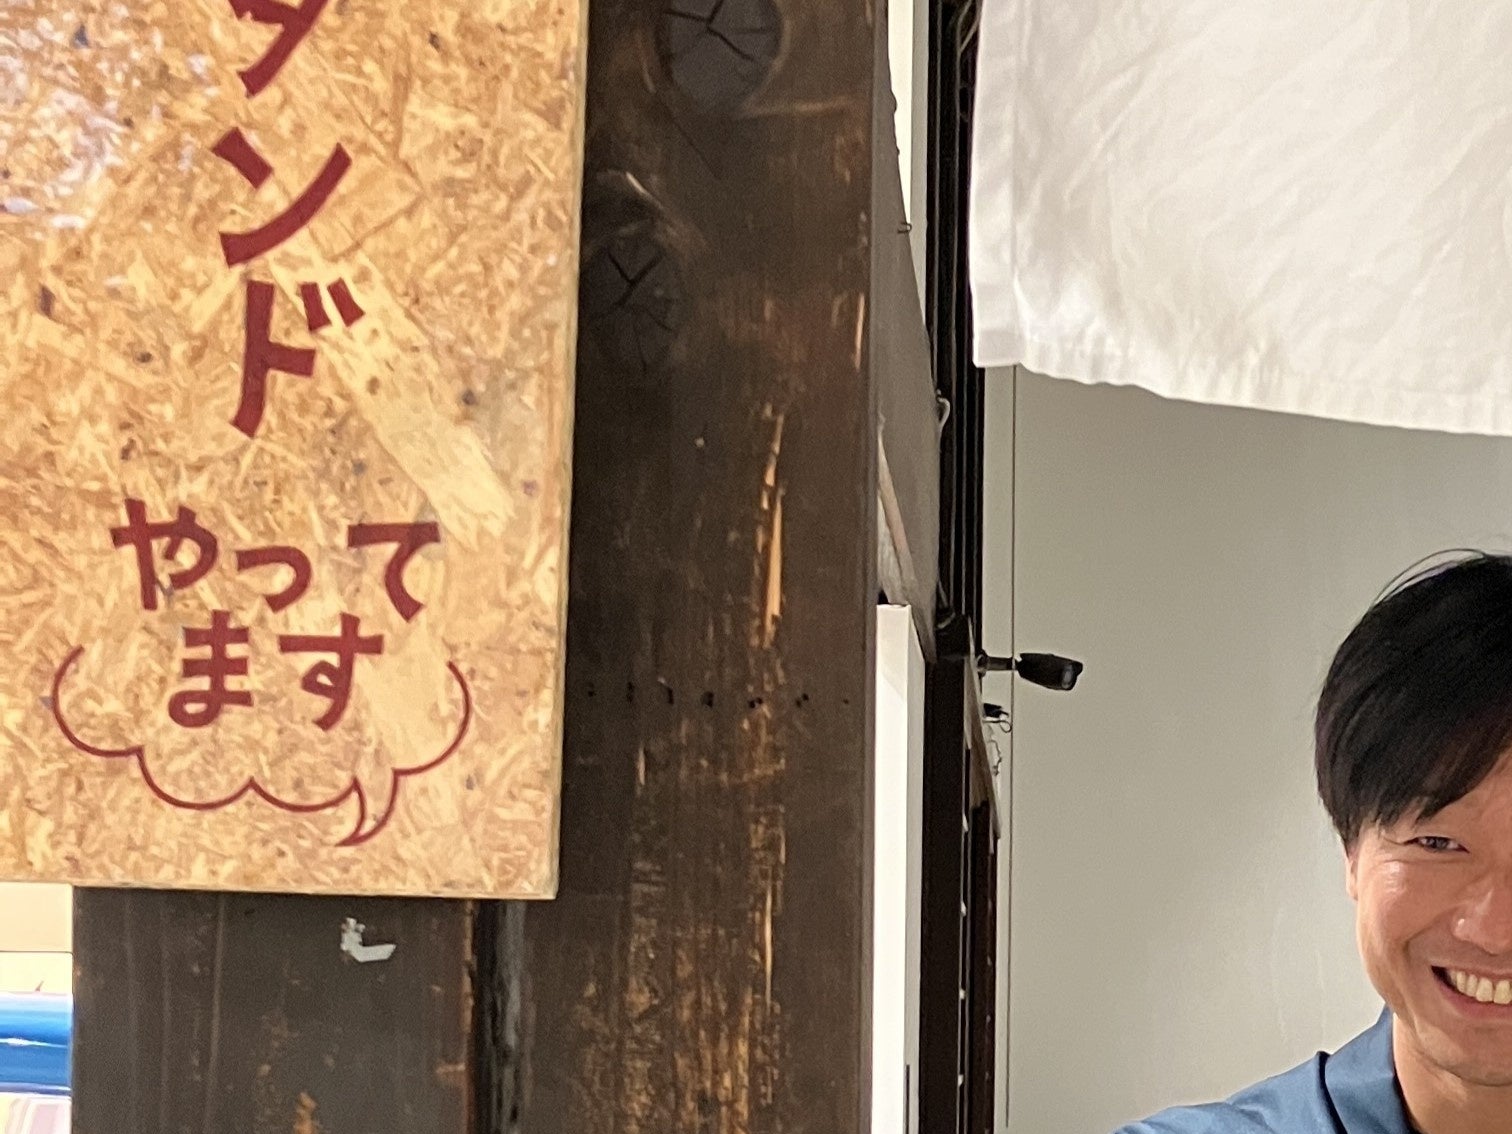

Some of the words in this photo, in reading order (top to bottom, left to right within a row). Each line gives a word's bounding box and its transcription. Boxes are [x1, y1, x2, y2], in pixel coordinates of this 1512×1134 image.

[111, 499, 440, 622] やって
[169, 611, 385, 730] ます
